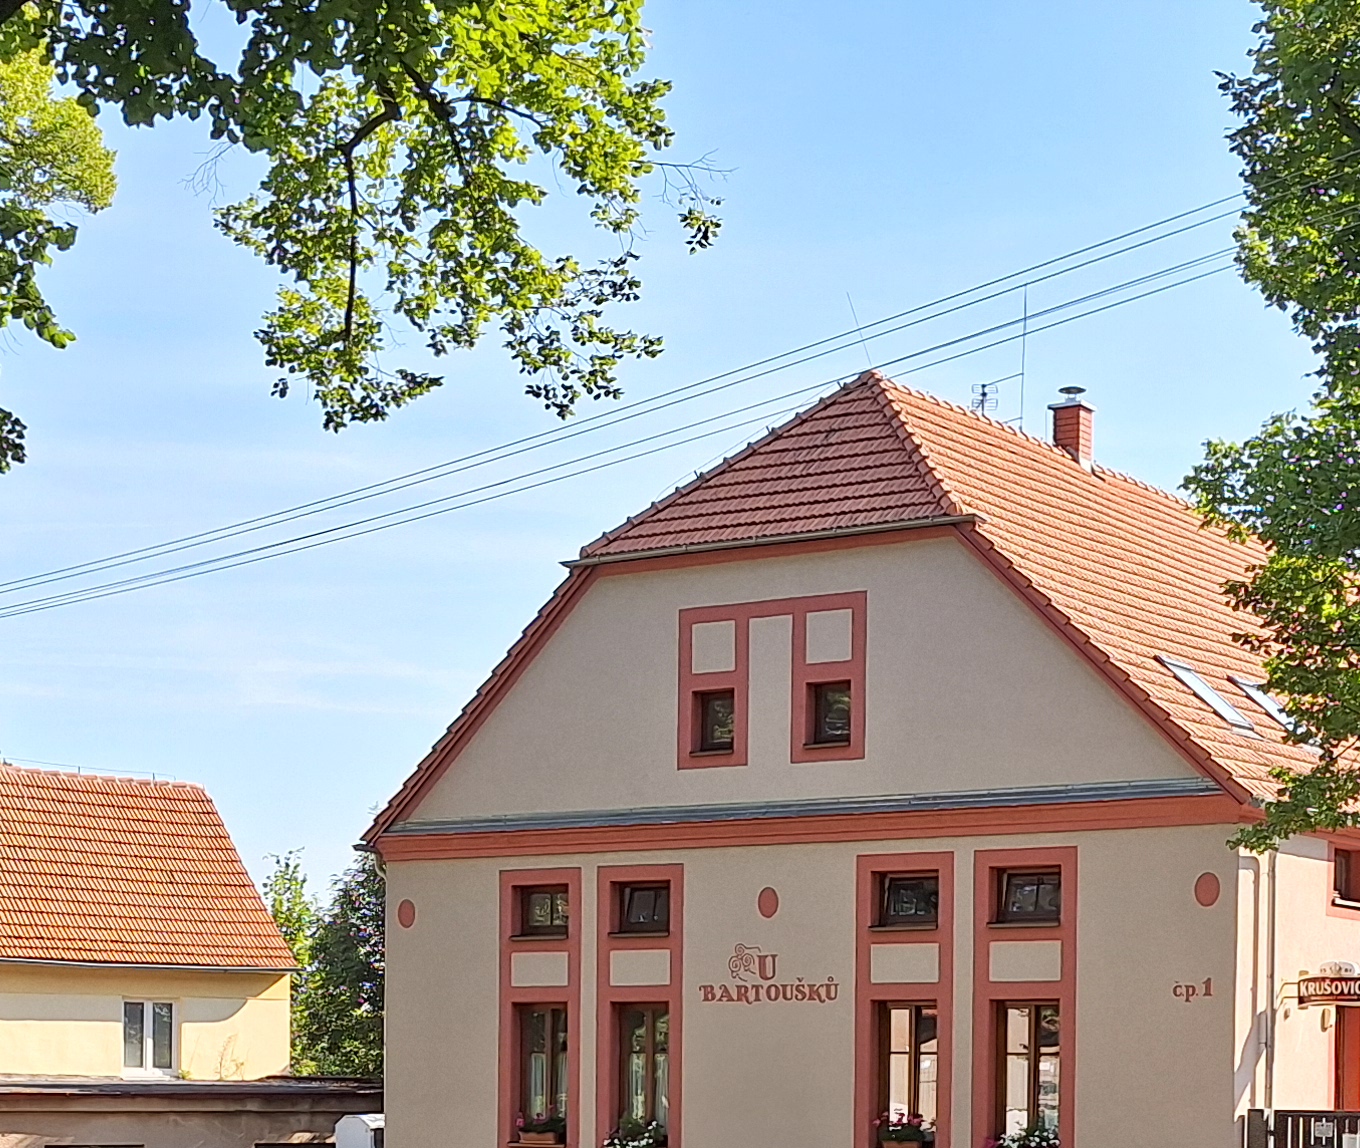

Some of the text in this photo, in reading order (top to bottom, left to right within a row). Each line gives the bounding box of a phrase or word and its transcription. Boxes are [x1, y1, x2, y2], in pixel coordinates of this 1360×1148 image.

[757, 954, 778, 981] U
[699, 976, 839, 1005] BARTOUŠKŮ
[1202, 977, 1213, 997] 1
